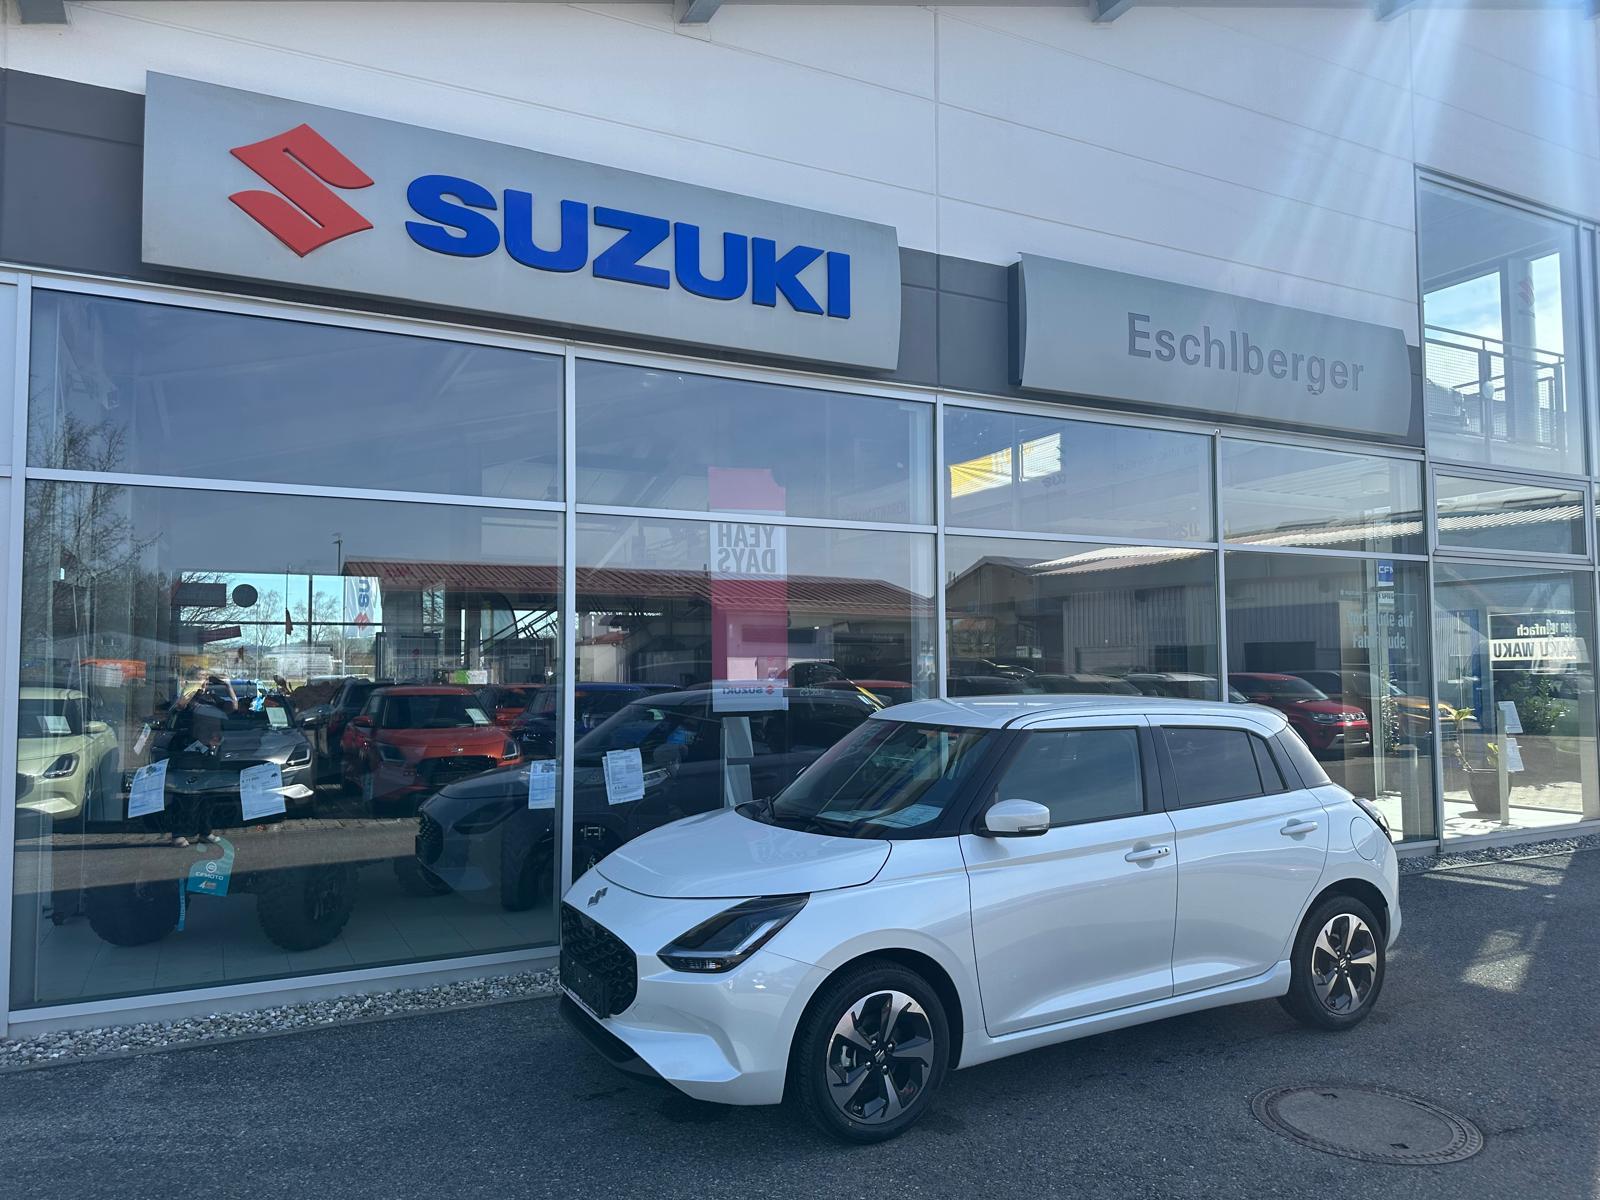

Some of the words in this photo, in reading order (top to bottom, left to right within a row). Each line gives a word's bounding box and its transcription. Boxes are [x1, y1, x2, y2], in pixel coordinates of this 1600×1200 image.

[405, 174, 851, 319] SUZUKI
[1127, 311, 1364, 395] Eschlberger
[1398, 611, 1414, 627] auf
